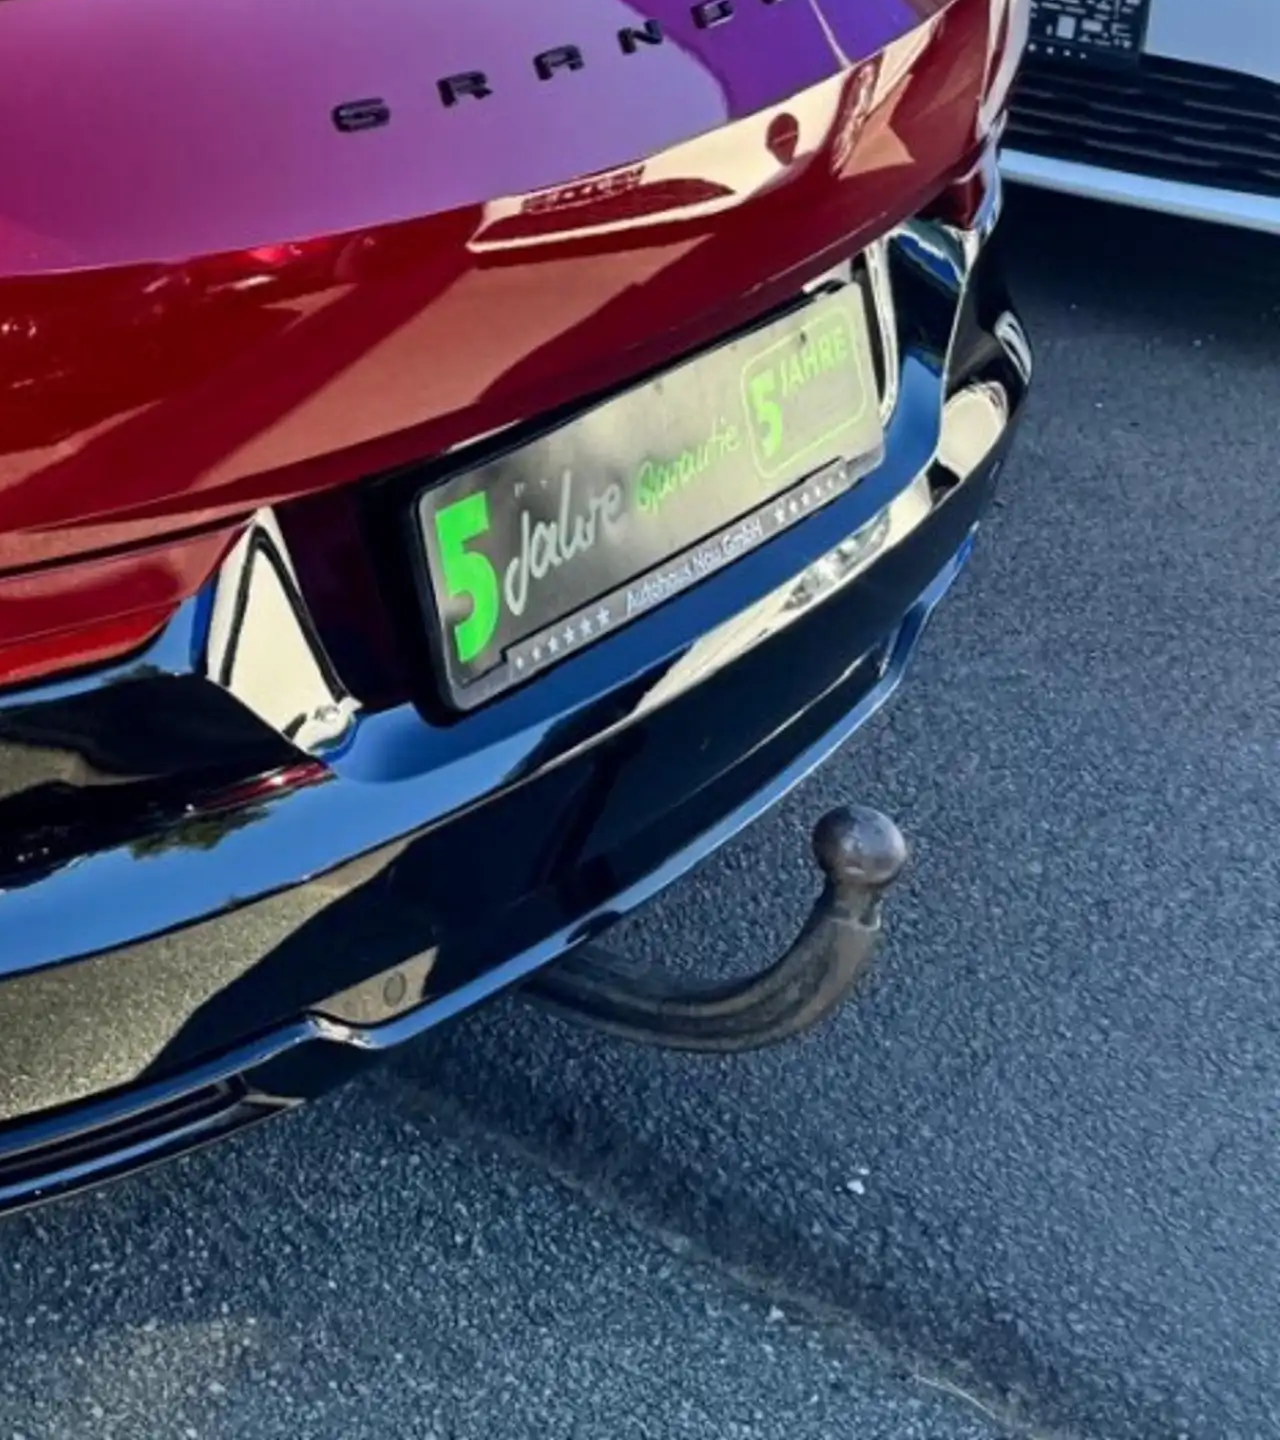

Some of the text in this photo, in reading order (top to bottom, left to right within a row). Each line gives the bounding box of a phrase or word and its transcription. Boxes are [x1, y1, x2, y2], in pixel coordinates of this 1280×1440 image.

[749, 326, 849, 457] 5 JAHRE
[435, 491, 498, 664] 5
[504, 469, 628, 616] Jahre
